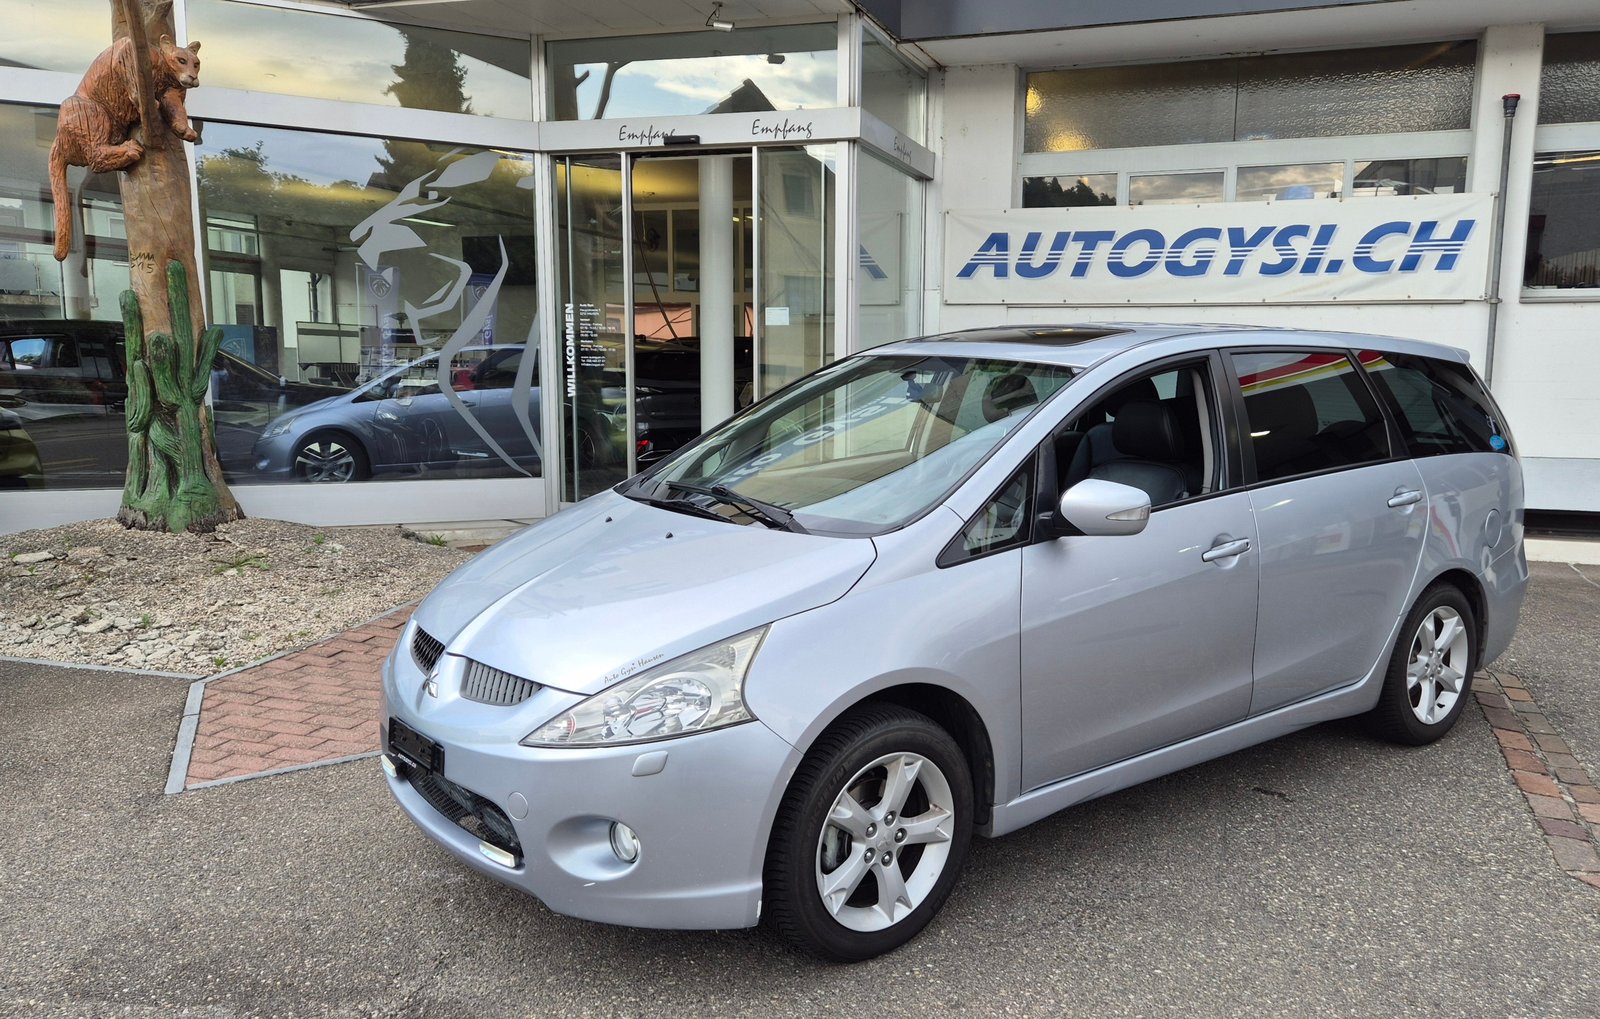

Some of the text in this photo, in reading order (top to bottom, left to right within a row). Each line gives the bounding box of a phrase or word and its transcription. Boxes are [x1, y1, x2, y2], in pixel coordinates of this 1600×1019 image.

[752, 118, 813, 138] Empfang
[955, 219, 1477, 280] AUTOGYSI.CH
[565, 303, 576, 397] WILLKOMMEN
